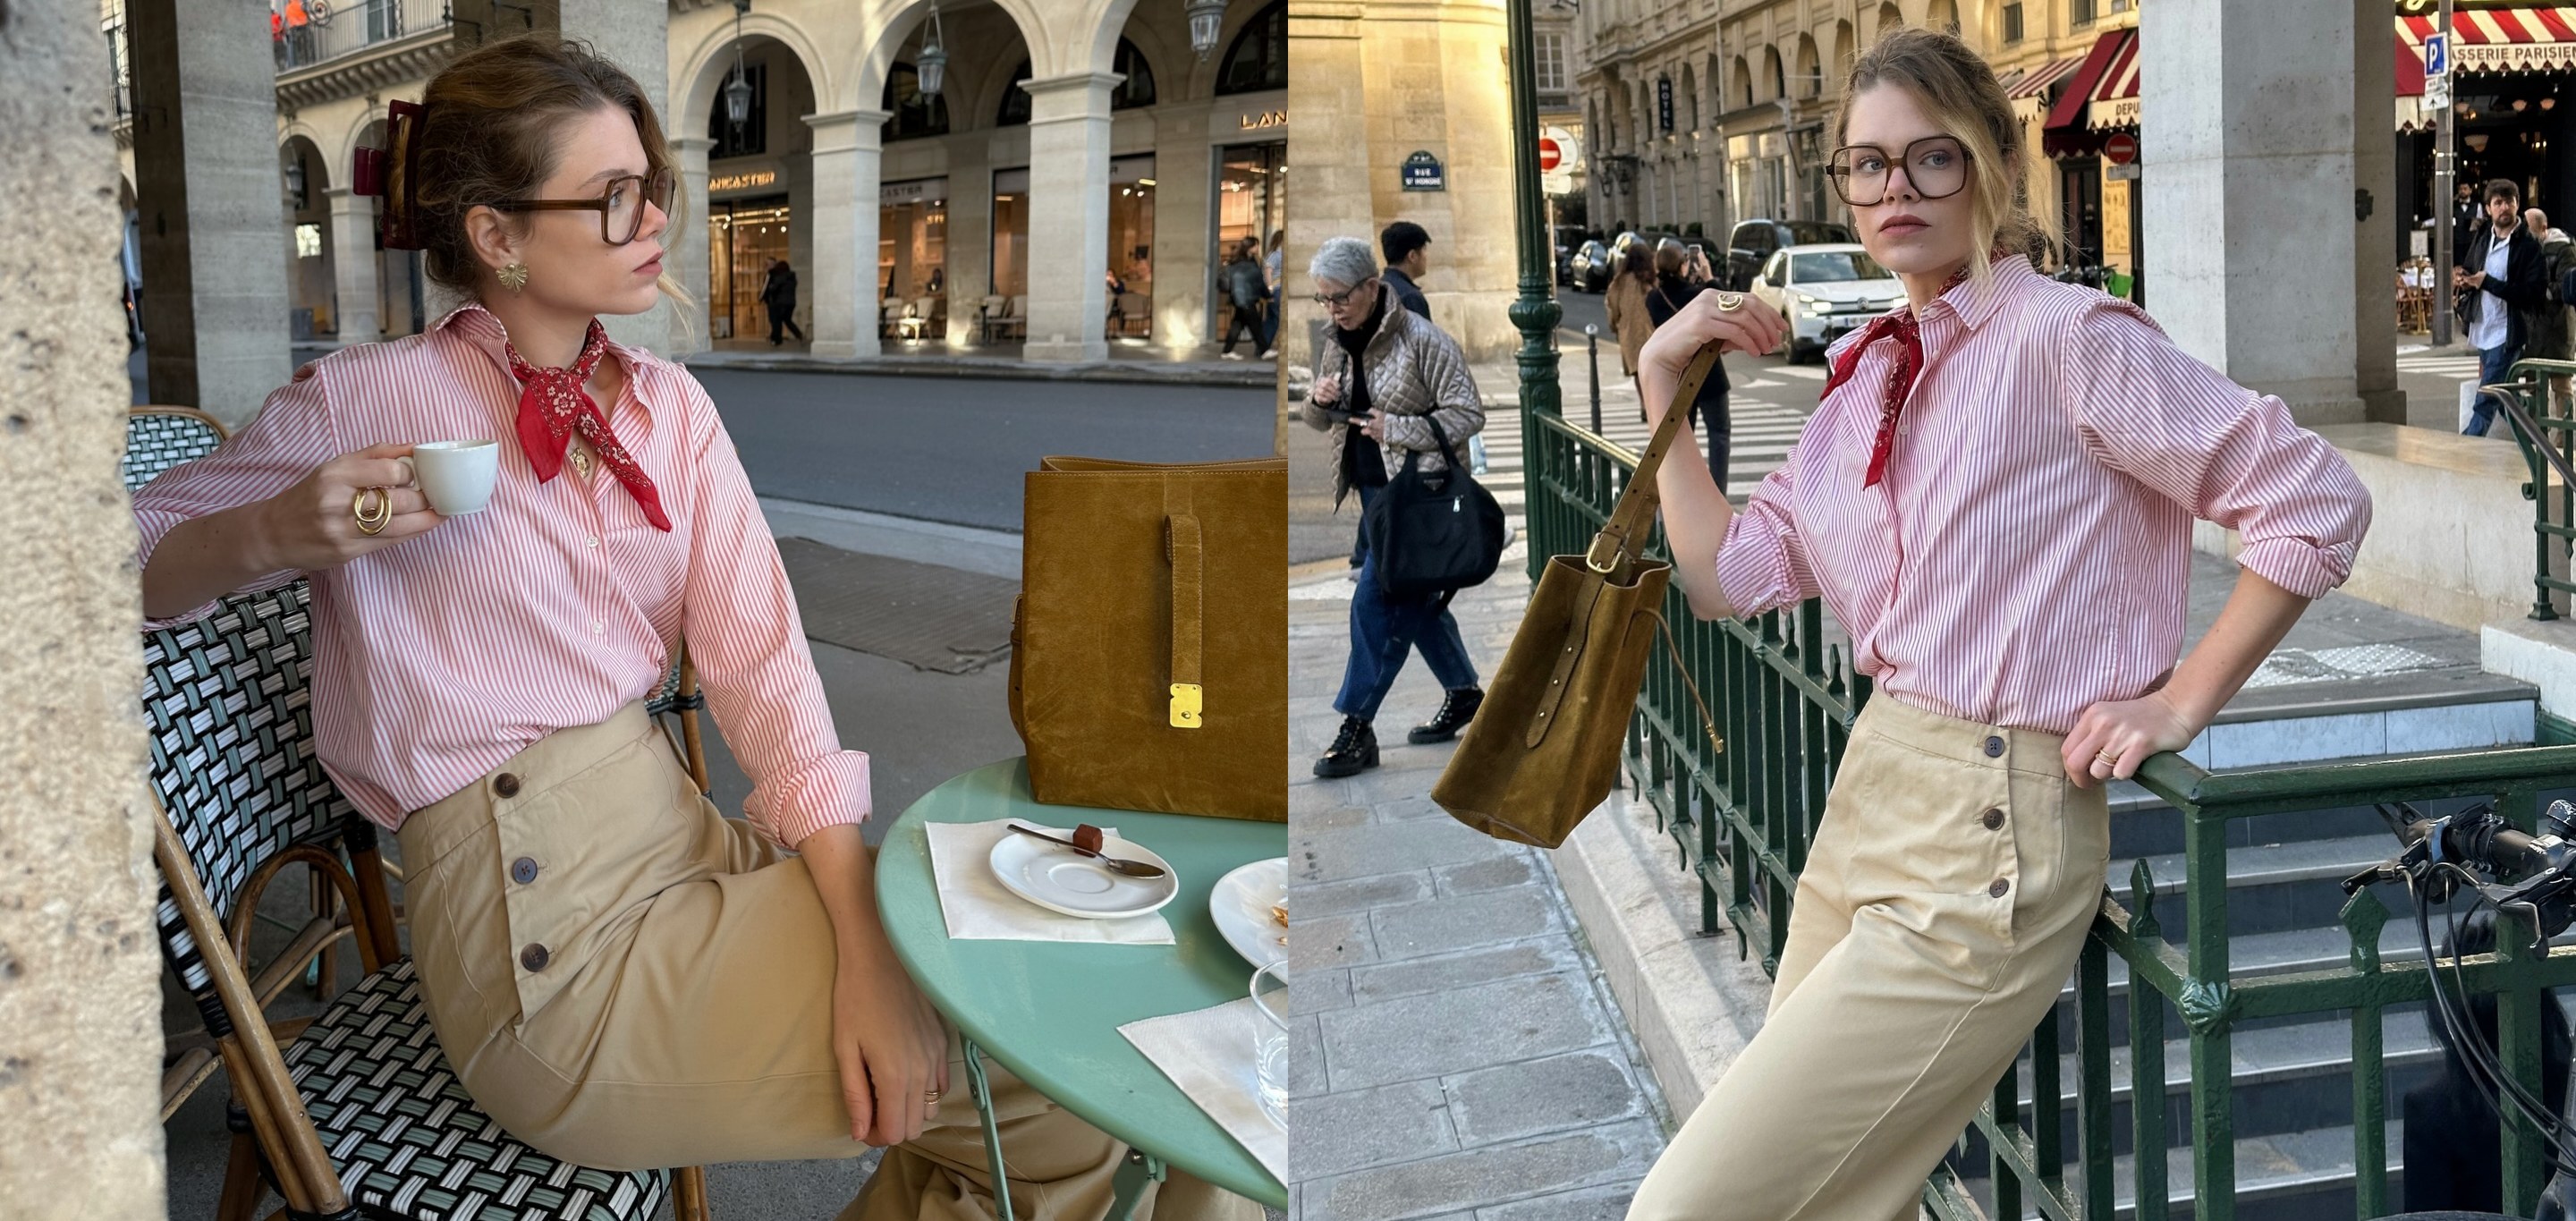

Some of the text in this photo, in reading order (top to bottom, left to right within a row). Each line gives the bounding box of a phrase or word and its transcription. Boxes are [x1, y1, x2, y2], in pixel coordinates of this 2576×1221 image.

[2429, 43, 2438, 70] P
[1661, 83, 1670, 127] HOTEL
[1414, 168, 1431, 176] RUE
